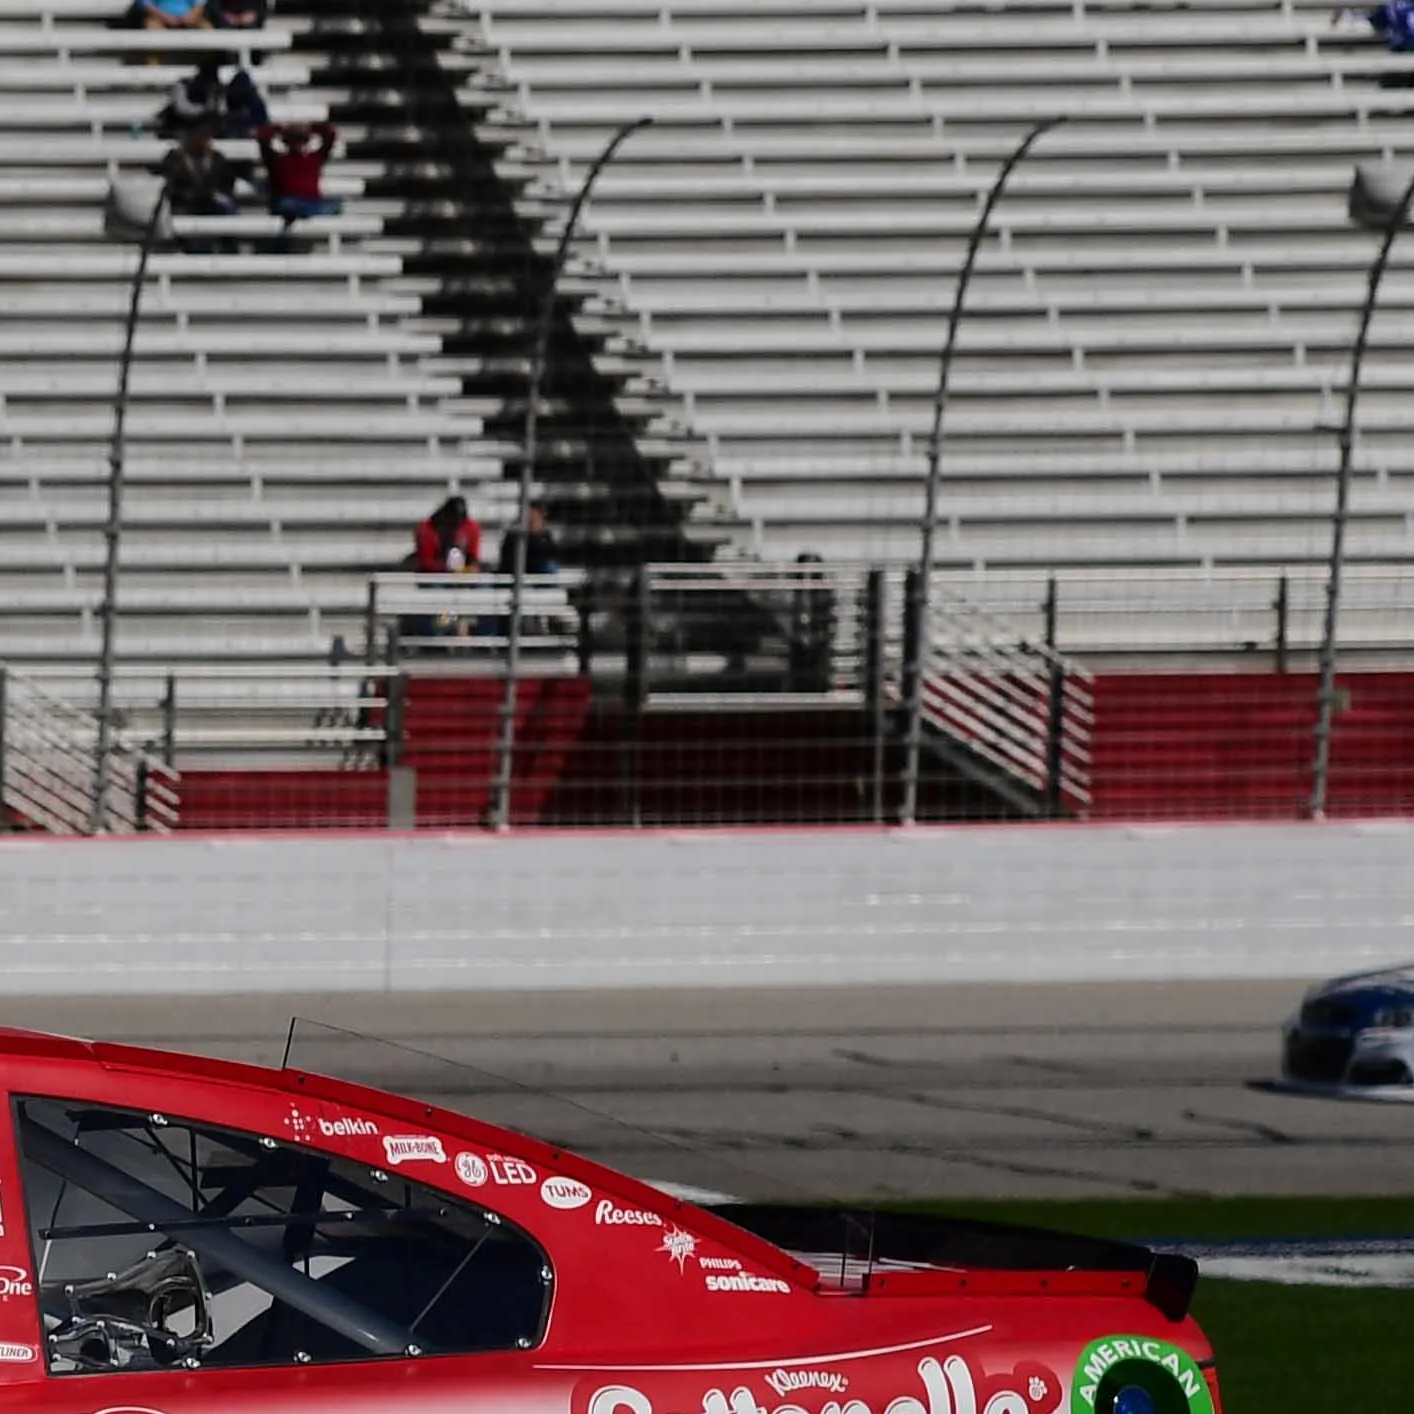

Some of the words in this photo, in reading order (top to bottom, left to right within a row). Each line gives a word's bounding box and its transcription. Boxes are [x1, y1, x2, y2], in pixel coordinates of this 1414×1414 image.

[318, 1117, 379, 1136] belkin
[489, 1161, 537, 1185] LED
[545, 1184, 589, 1199] TUMS
[699, 1256, 742, 1270] PHILIPS
[705, 1271, 791, 1293] sonicare
[763, 1367, 845, 1396] Kleenex
[1079, 1339, 1201, 1408] AMERICAN
